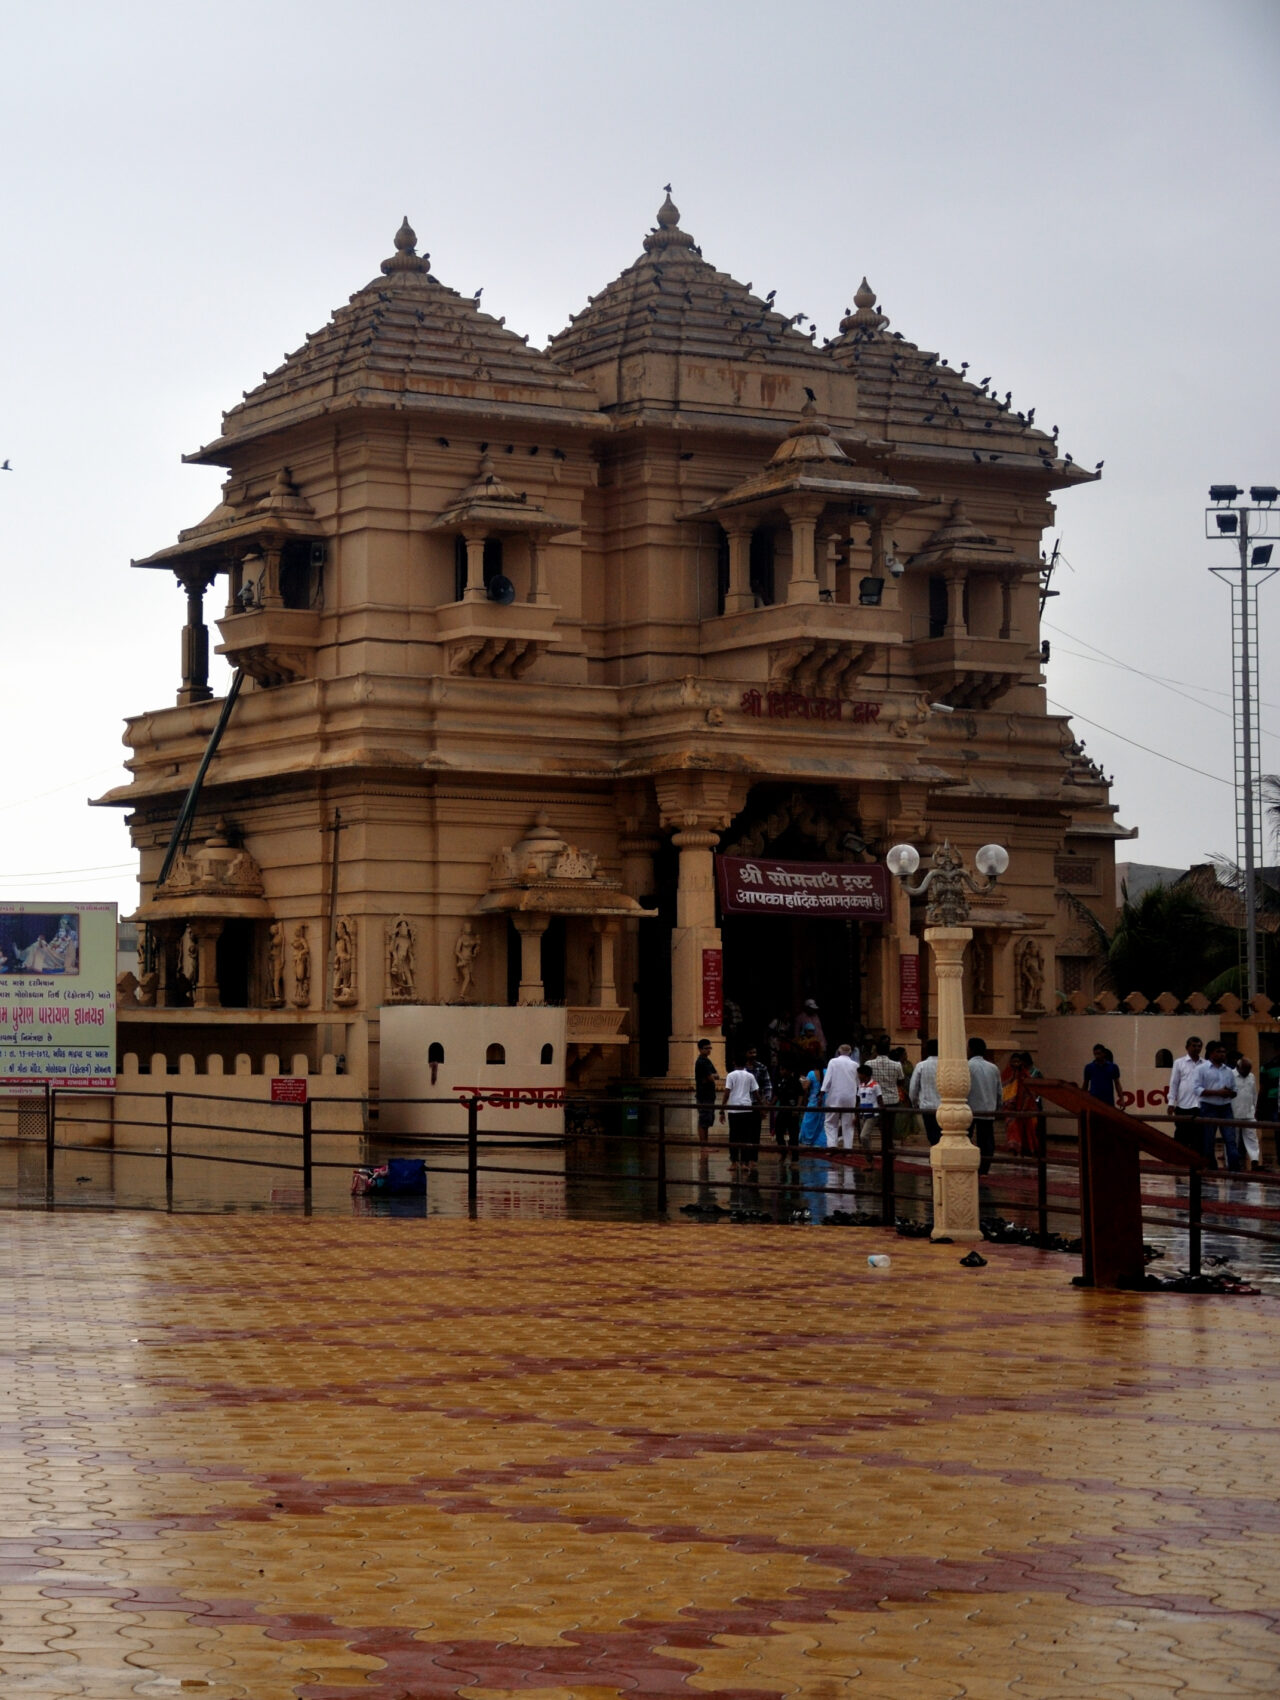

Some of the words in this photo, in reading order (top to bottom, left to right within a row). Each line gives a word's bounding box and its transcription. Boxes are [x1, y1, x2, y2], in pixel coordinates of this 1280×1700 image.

[740, 688, 763, 718] श्री
[851, 700, 883, 726] द्वार
[739, 863, 764, 886] श्री
[767, 866, 838, 889] सोमनाथ
[841, 874, 874, 891] ट्रस्ट
[736, 889, 784, 905] आपका
[785, 890, 819, 908] हार्दिक
[818, 894, 849, 908] स्वागत
[12, 1006, 34, 1031] પુરાણ
[39, 1007, 70, 1025] પારાયણ
[74, 1007, 105, 1026] જ્ઞાનયજ્ઞ
